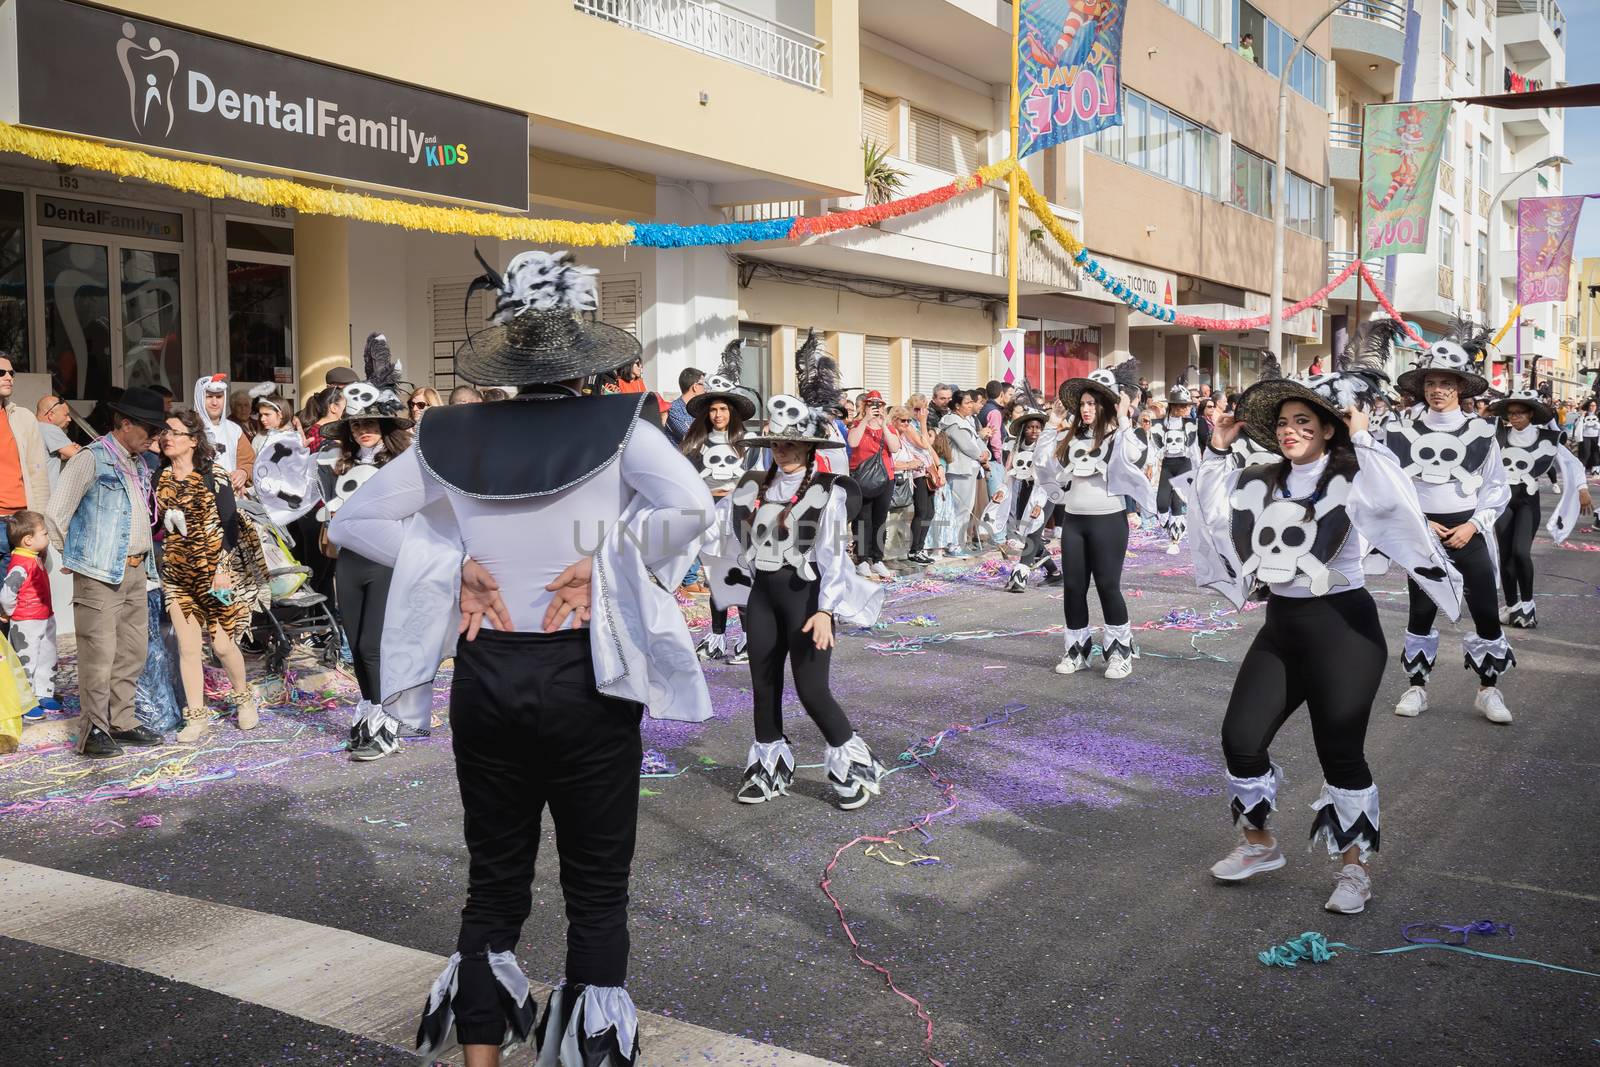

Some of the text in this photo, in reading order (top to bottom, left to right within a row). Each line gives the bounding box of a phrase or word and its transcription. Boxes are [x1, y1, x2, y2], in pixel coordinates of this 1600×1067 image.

[188, 70, 469, 167] DentalFamily and KIDS
[59, 176, 79, 189] 153
[44, 202, 155, 235] DentalFamily
[271, 207, 286, 218] 155
[1128, 275, 1141, 291] TICO
[1143, 279, 1156, 294] TICO
